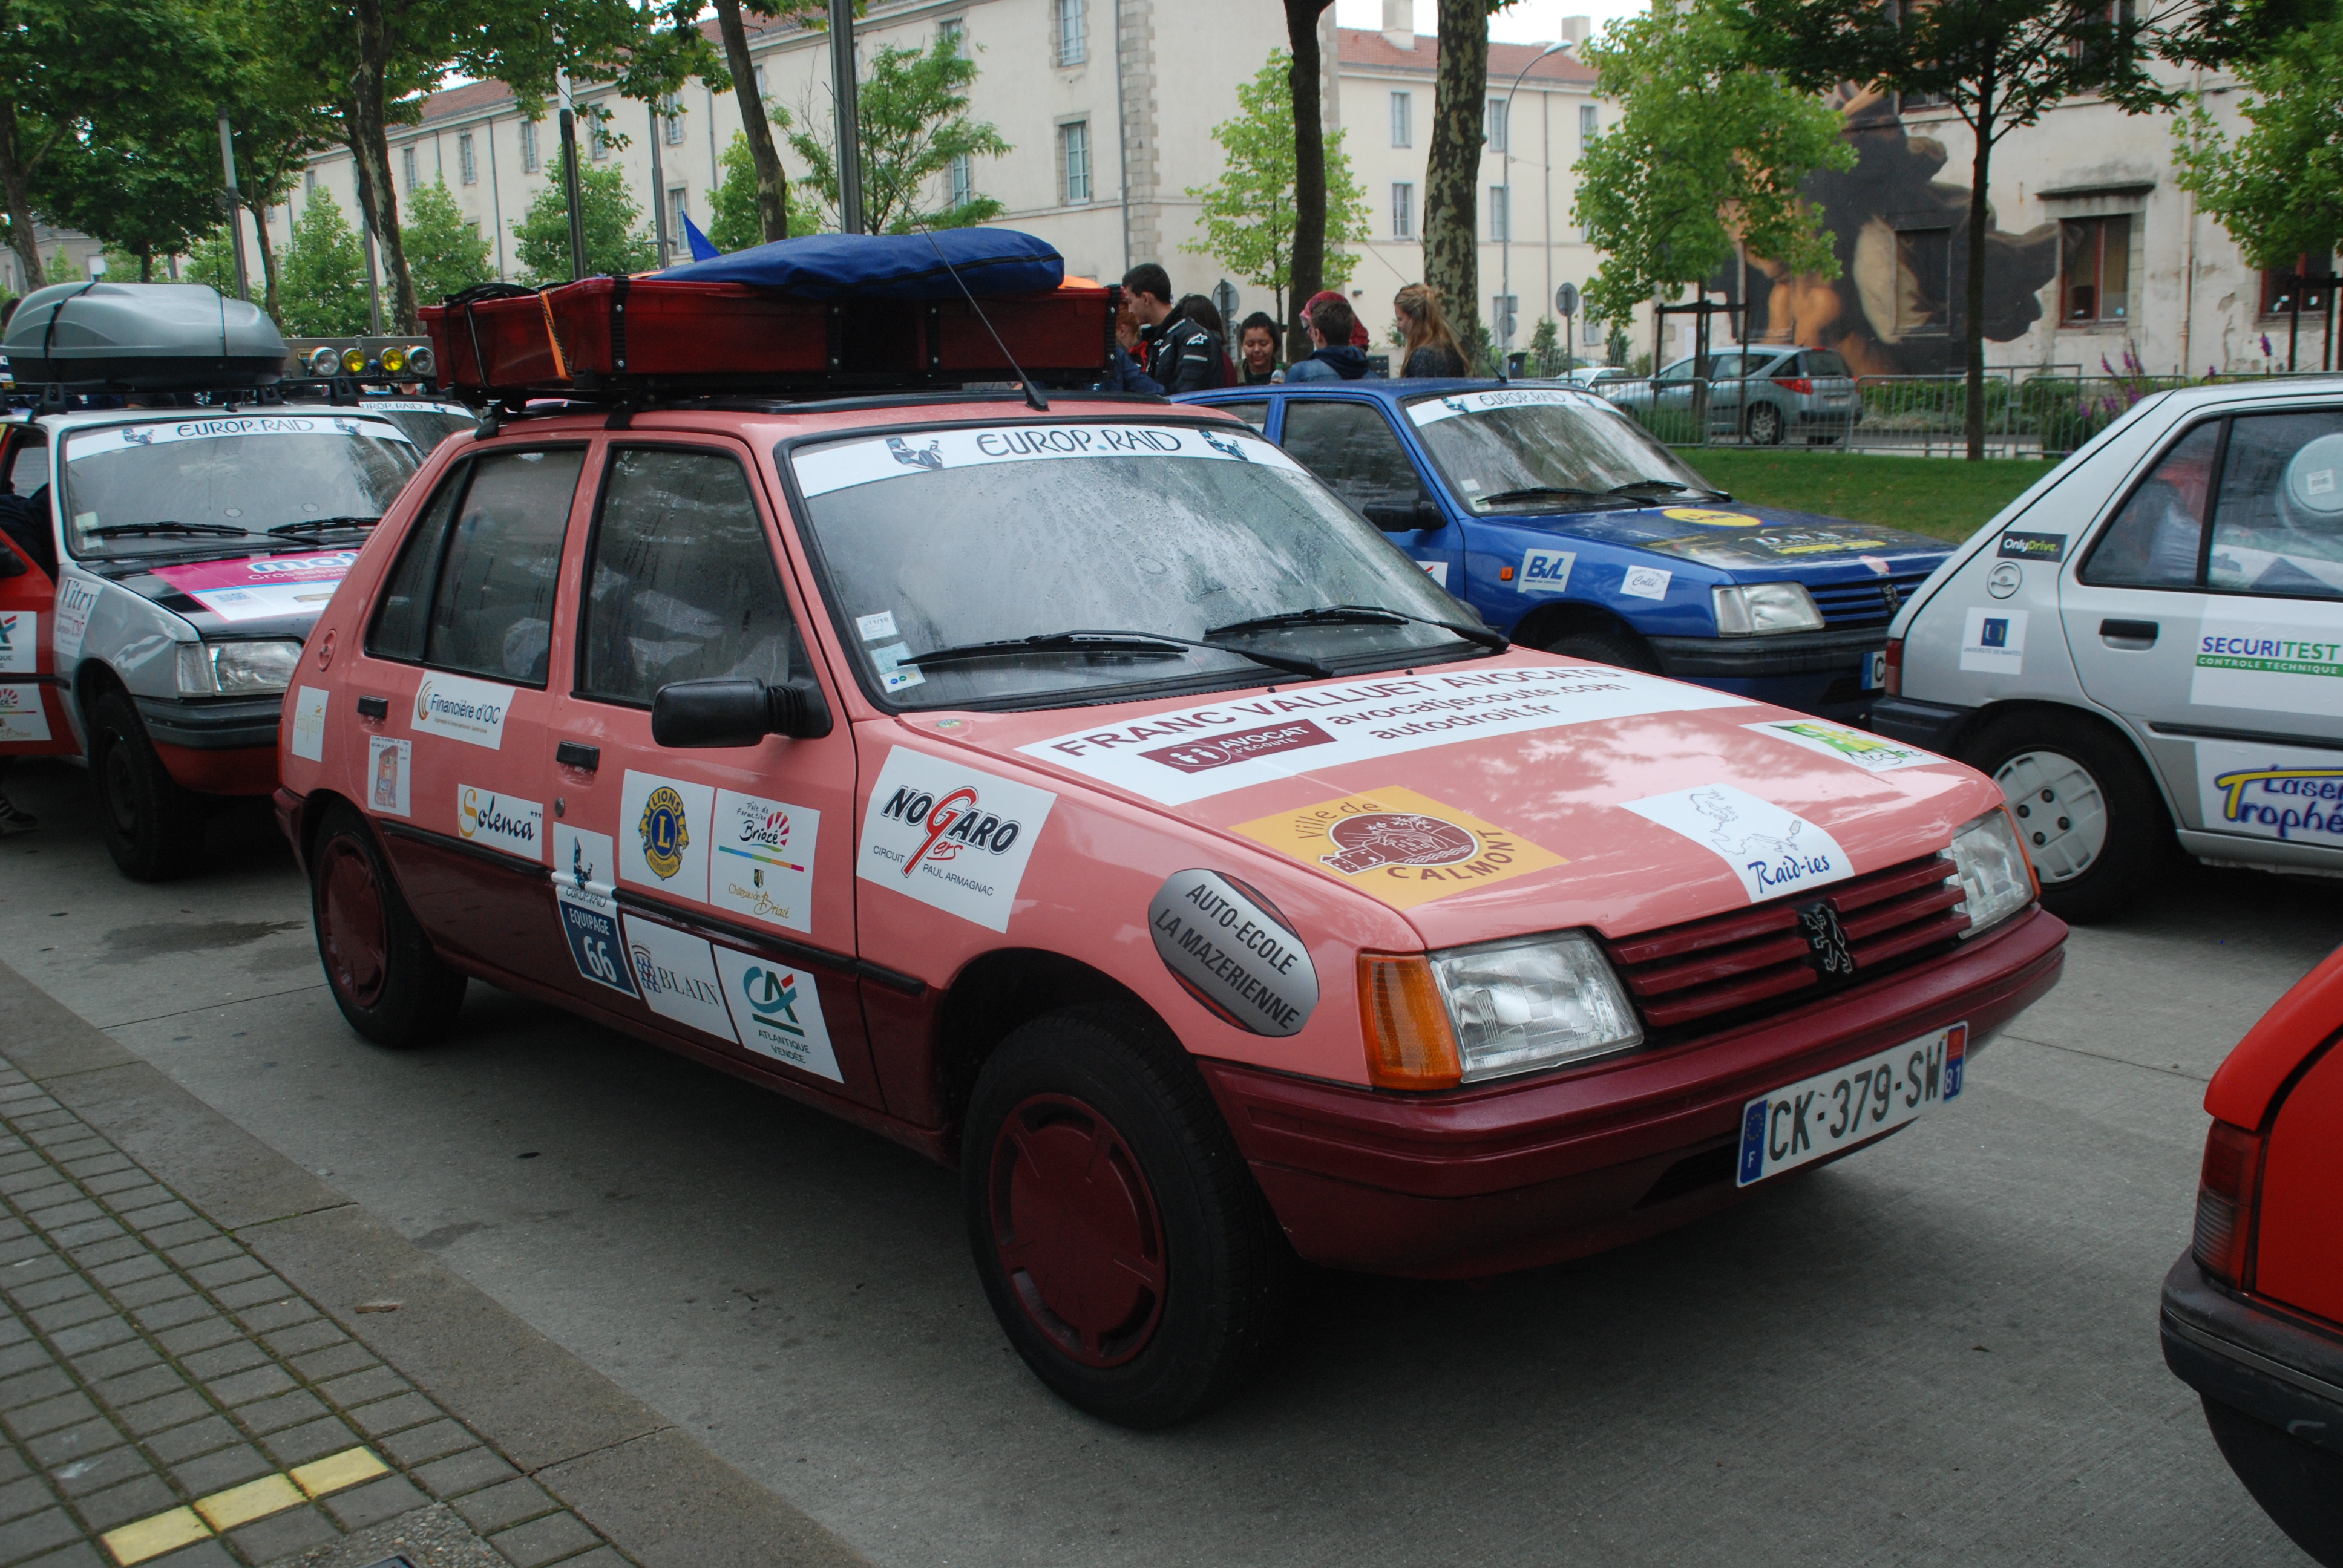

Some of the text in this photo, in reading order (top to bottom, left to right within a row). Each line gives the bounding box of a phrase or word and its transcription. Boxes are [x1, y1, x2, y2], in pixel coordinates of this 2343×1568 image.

[178, 419, 315, 437] EUROP.RAID
[976, 430, 1182, 457] EUROP.RAID
[2004, 538, 2056, 552] OnlyDrive
[868, 617, 889, 626] 11/18
[2201, 636, 2341, 661] SECURITEST
[2198, 656, 2338, 675] CONTROLE TECHNIQUE
[431, 694, 474, 719] Financière
[1050, 668, 1623, 757] FRANC VALLUET AVOCATS
[1369, 702, 1561, 740] autodroit.fr
[1218, 726, 1311, 750] AVOCAT
[459, 788, 535, 841] Solenca
[652, 790, 681, 813] LIONS
[736, 808, 767, 822] Formation
[746, 801, 759, 812] Pôle
[657, 815, 670, 848] L
[739, 820, 778, 845] Briacé
[881, 785, 1021, 878] NOGARO
[1295, 802, 1382, 840] Ville de
[649, 852, 677, 873] INTERNATIONAL
[873, 846, 905, 864] CIRCUIT
[1386, 829, 1515, 881] CALMONT
[923, 863, 994, 897] PAUL ARMAGNAC
[1747, 855, 1830, 894] Raid-ies
[754, 891, 790, 919] Briacé
[569, 909, 610, 936] EQUIPAGE
[1184, 883, 1299, 976] AUTO-ECOLE
[583, 935, 617, 983] 66
[1154, 908, 1300, 1030] LA MAZERIENNE
[656, 965, 720, 1008] BLAIN
[758, 1028, 811, 1054] ATLANTIQUE
[770, 1044, 807, 1064] VENDÉE
[1944, 1065, 1961, 1094] 81
[1768, 1040, 1944, 1161] CK-379-SW
[1748, 1151, 1756, 1168] F
